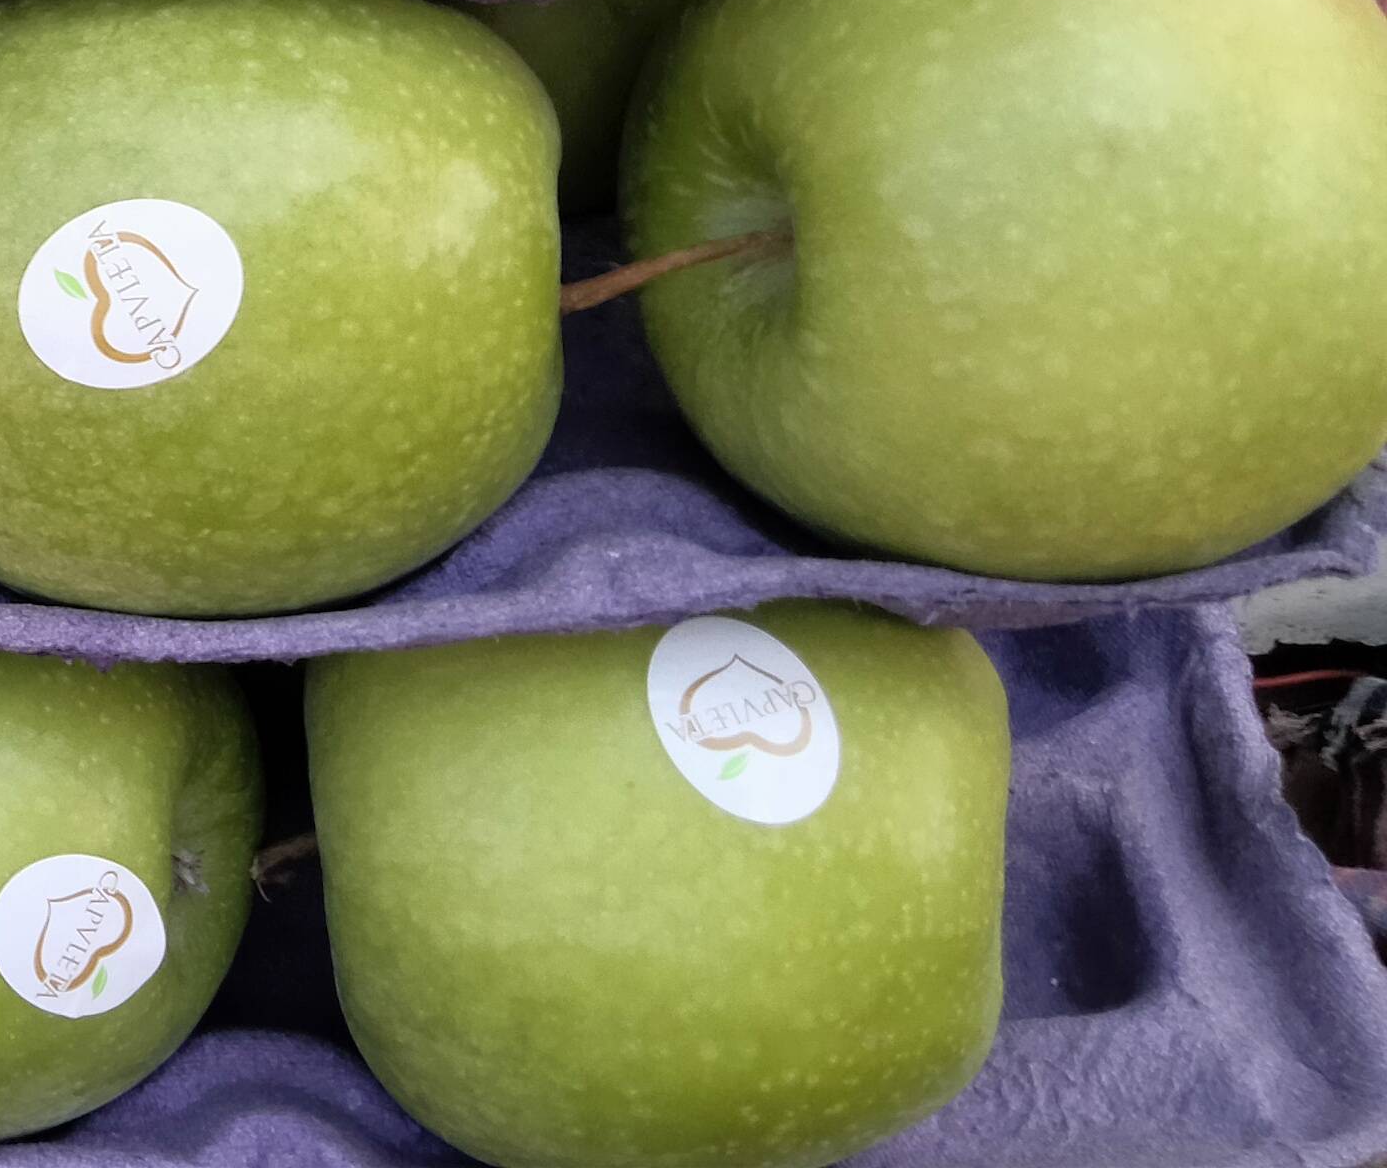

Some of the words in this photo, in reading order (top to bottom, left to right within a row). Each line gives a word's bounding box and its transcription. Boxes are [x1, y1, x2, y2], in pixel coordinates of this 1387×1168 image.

[87, 220, 182, 370] CAPVLETA
[666, 680, 817, 742] CAPVLETA
[36, 870, 119, 1000] CAPVLETA
